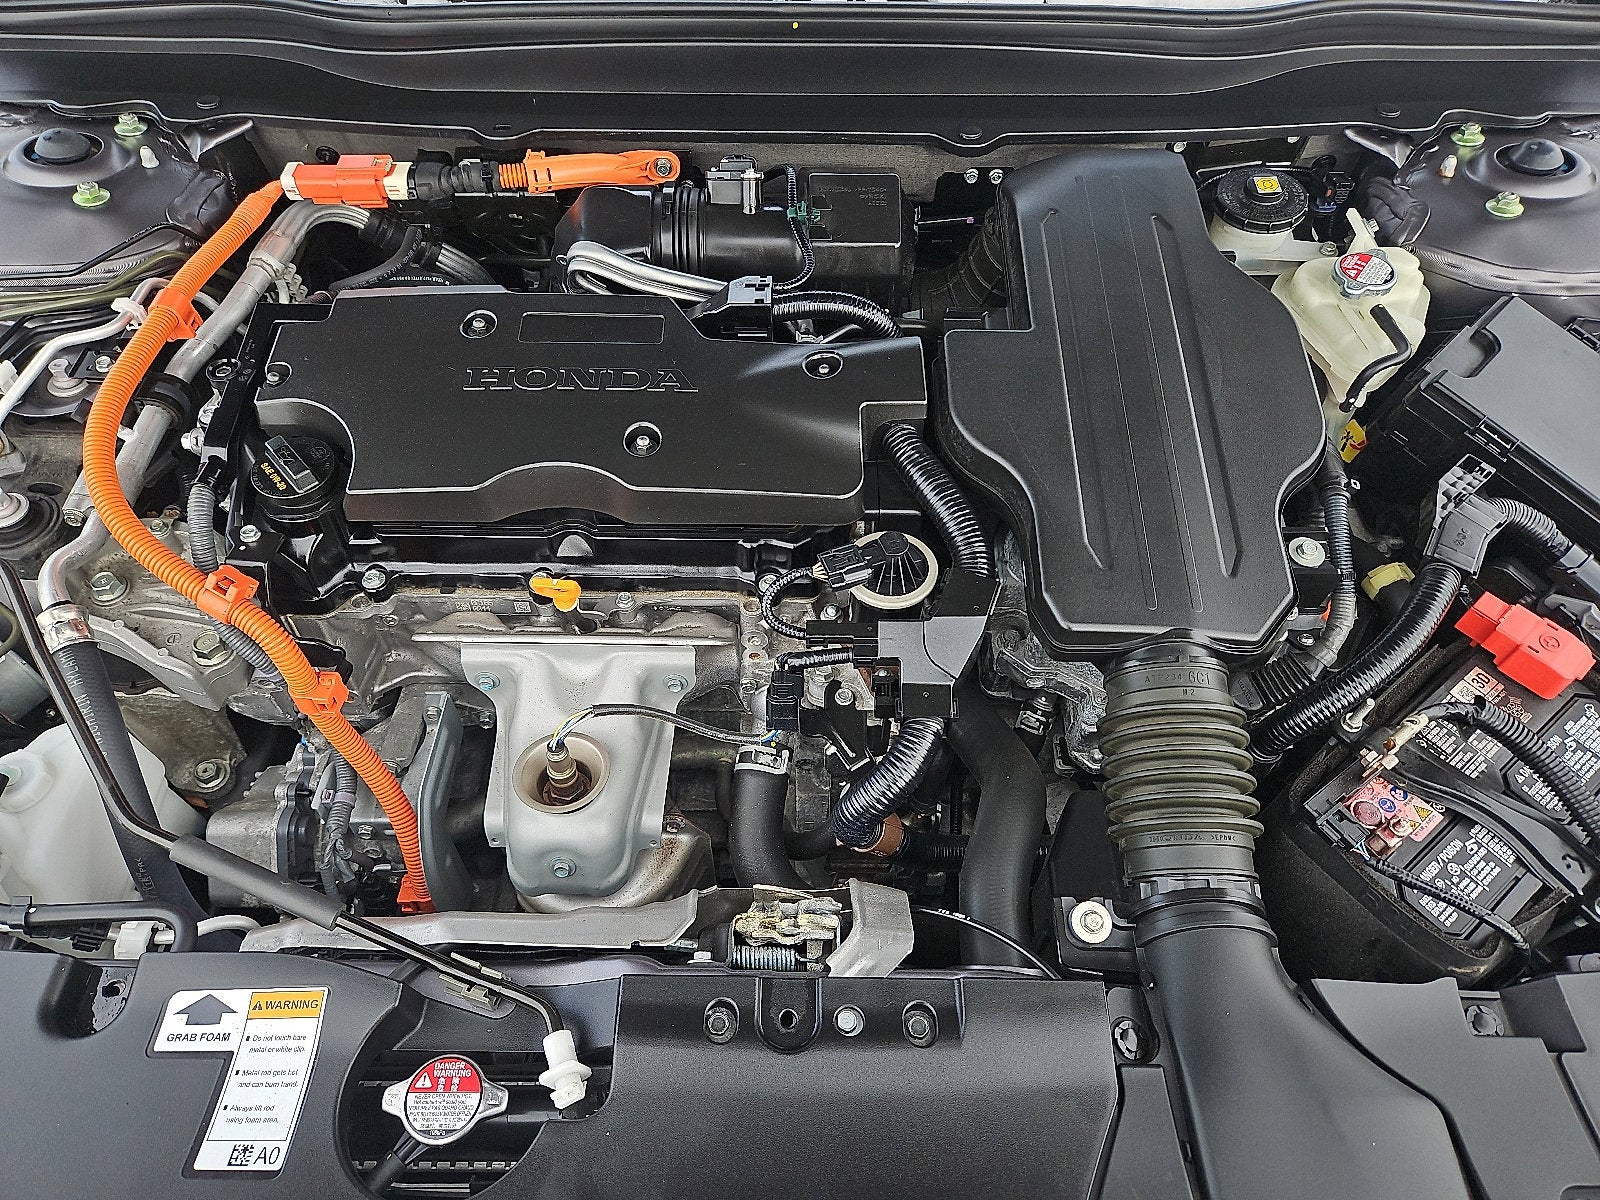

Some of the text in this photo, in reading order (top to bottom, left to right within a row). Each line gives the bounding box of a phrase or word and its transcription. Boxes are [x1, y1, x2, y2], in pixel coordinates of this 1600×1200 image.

[463, 366, 699, 392] HONDA
[260, 462, 275, 476] SAE
[265, 1000, 319, 1010] WARNING
[166, 1032, 231, 1042] GRAB FOAM
[434, 1062, 466, 1070] DANGER
[433, 1069, 472, 1077] WARNUNG
[253, 1146, 281, 1165] A0
